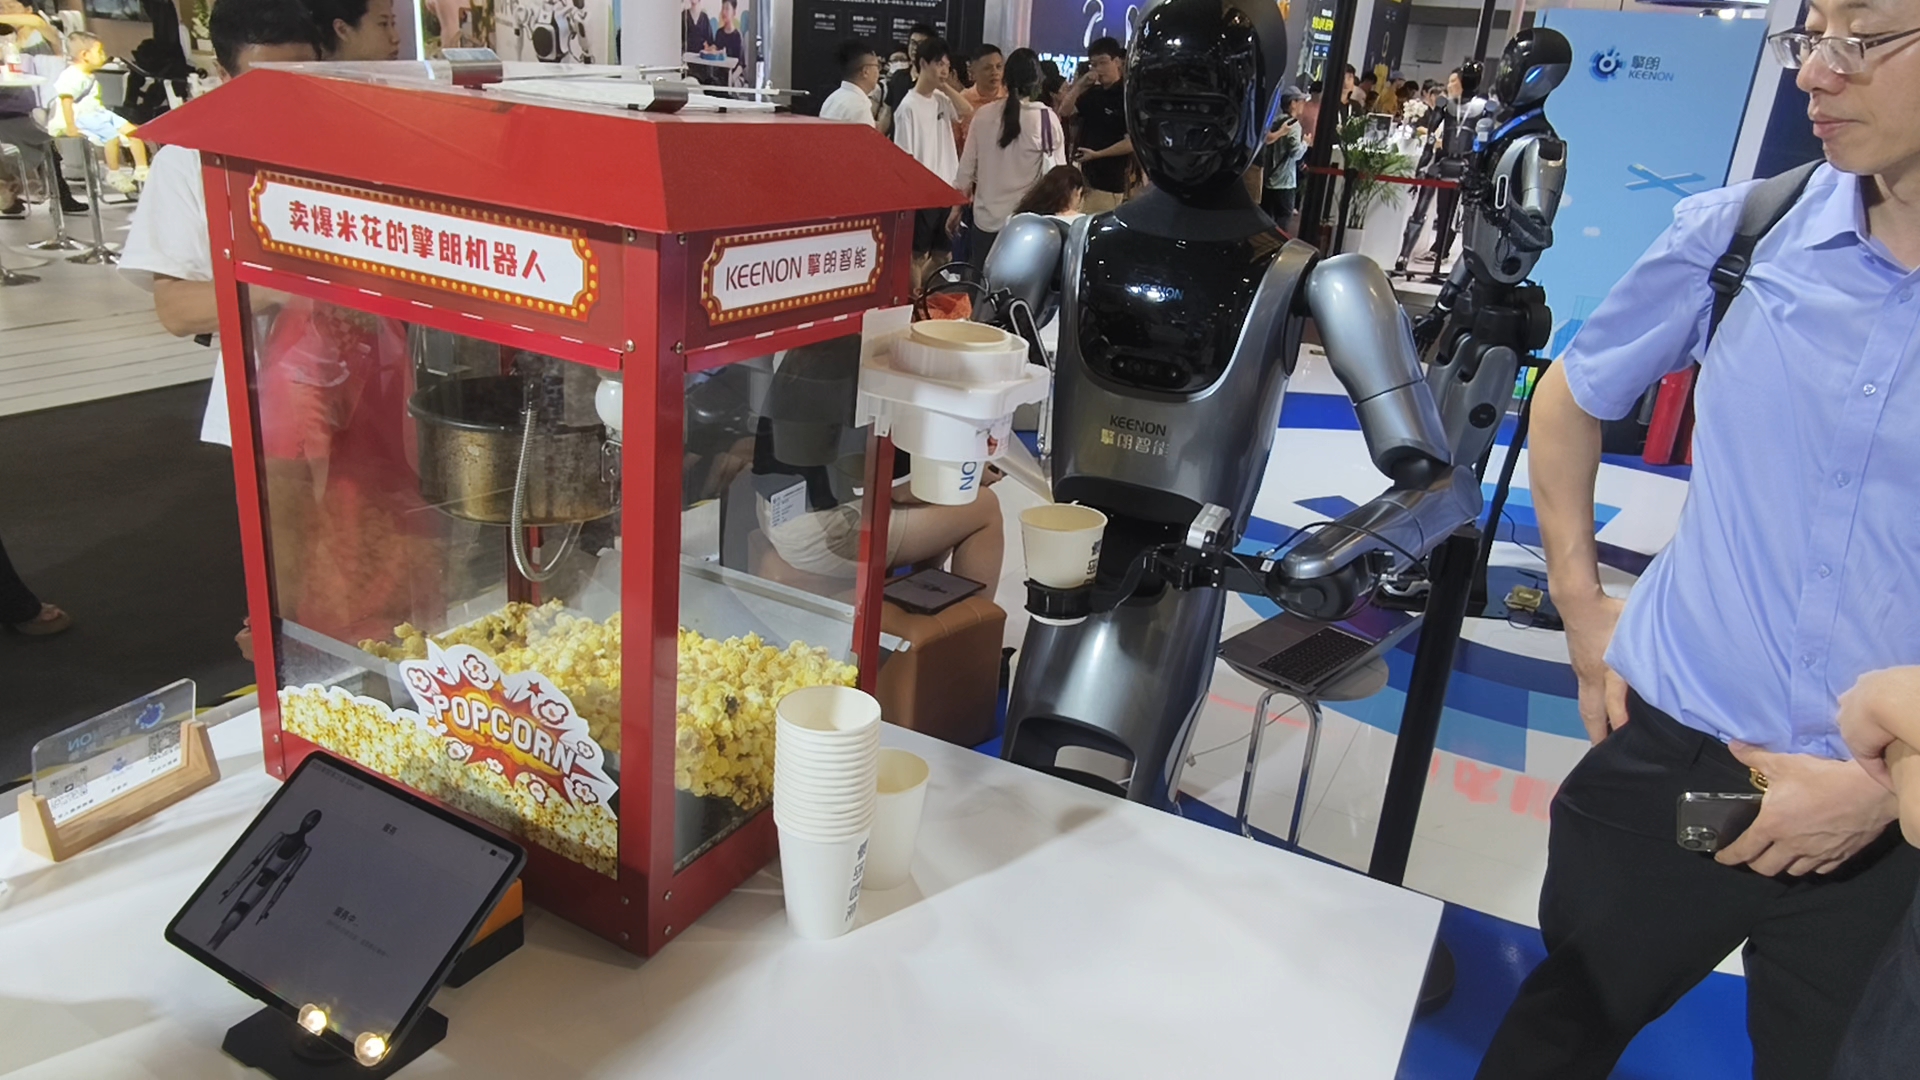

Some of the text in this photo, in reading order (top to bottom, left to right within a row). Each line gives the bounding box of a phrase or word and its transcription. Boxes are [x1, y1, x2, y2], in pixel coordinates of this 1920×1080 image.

[1628, 69, 1675, 82] KEENON
[289, 200, 546, 283] 卖爆米花的擎朗机器人
[726, 246, 867, 291] KEENON 擎朗智能
[1100, 428, 1169, 457] 擎朗智能
[1109, 414, 1167, 436] KEENON
[432, 693, 577, 777] POPCORN
